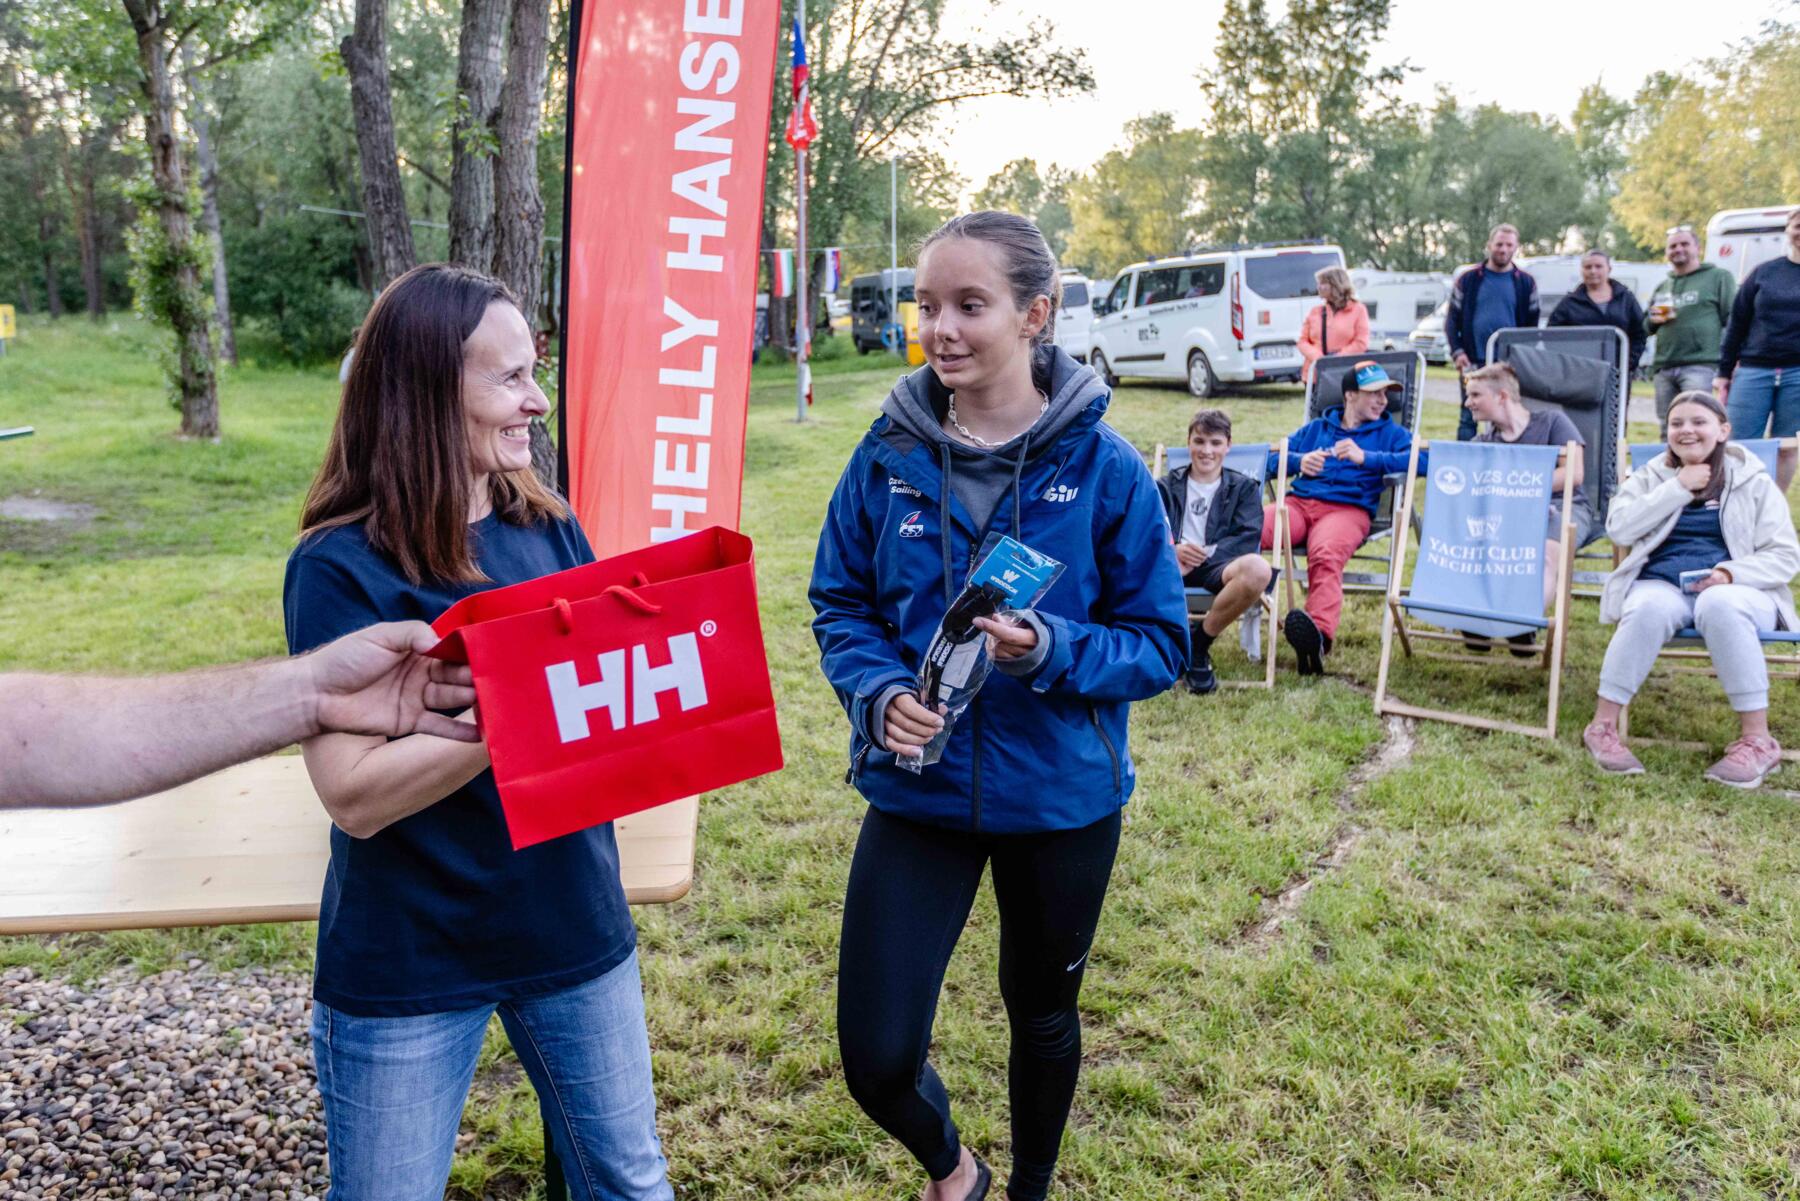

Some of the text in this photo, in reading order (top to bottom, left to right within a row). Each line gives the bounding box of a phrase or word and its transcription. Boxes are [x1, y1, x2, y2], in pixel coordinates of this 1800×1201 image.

[650, 295, 719, 543] HELLY
[1472, 470, 1544, 486] VZS ČČK
[890, 485, 922, 498] Sailing
[1042, 484, 1079, 503] Gill
[1471, 487, 1544, 498] NECHRANICE
[1429, 536, 1537, 562] YACHT CLUB
[1427, 553, 1537, 576] NECHRANICE
